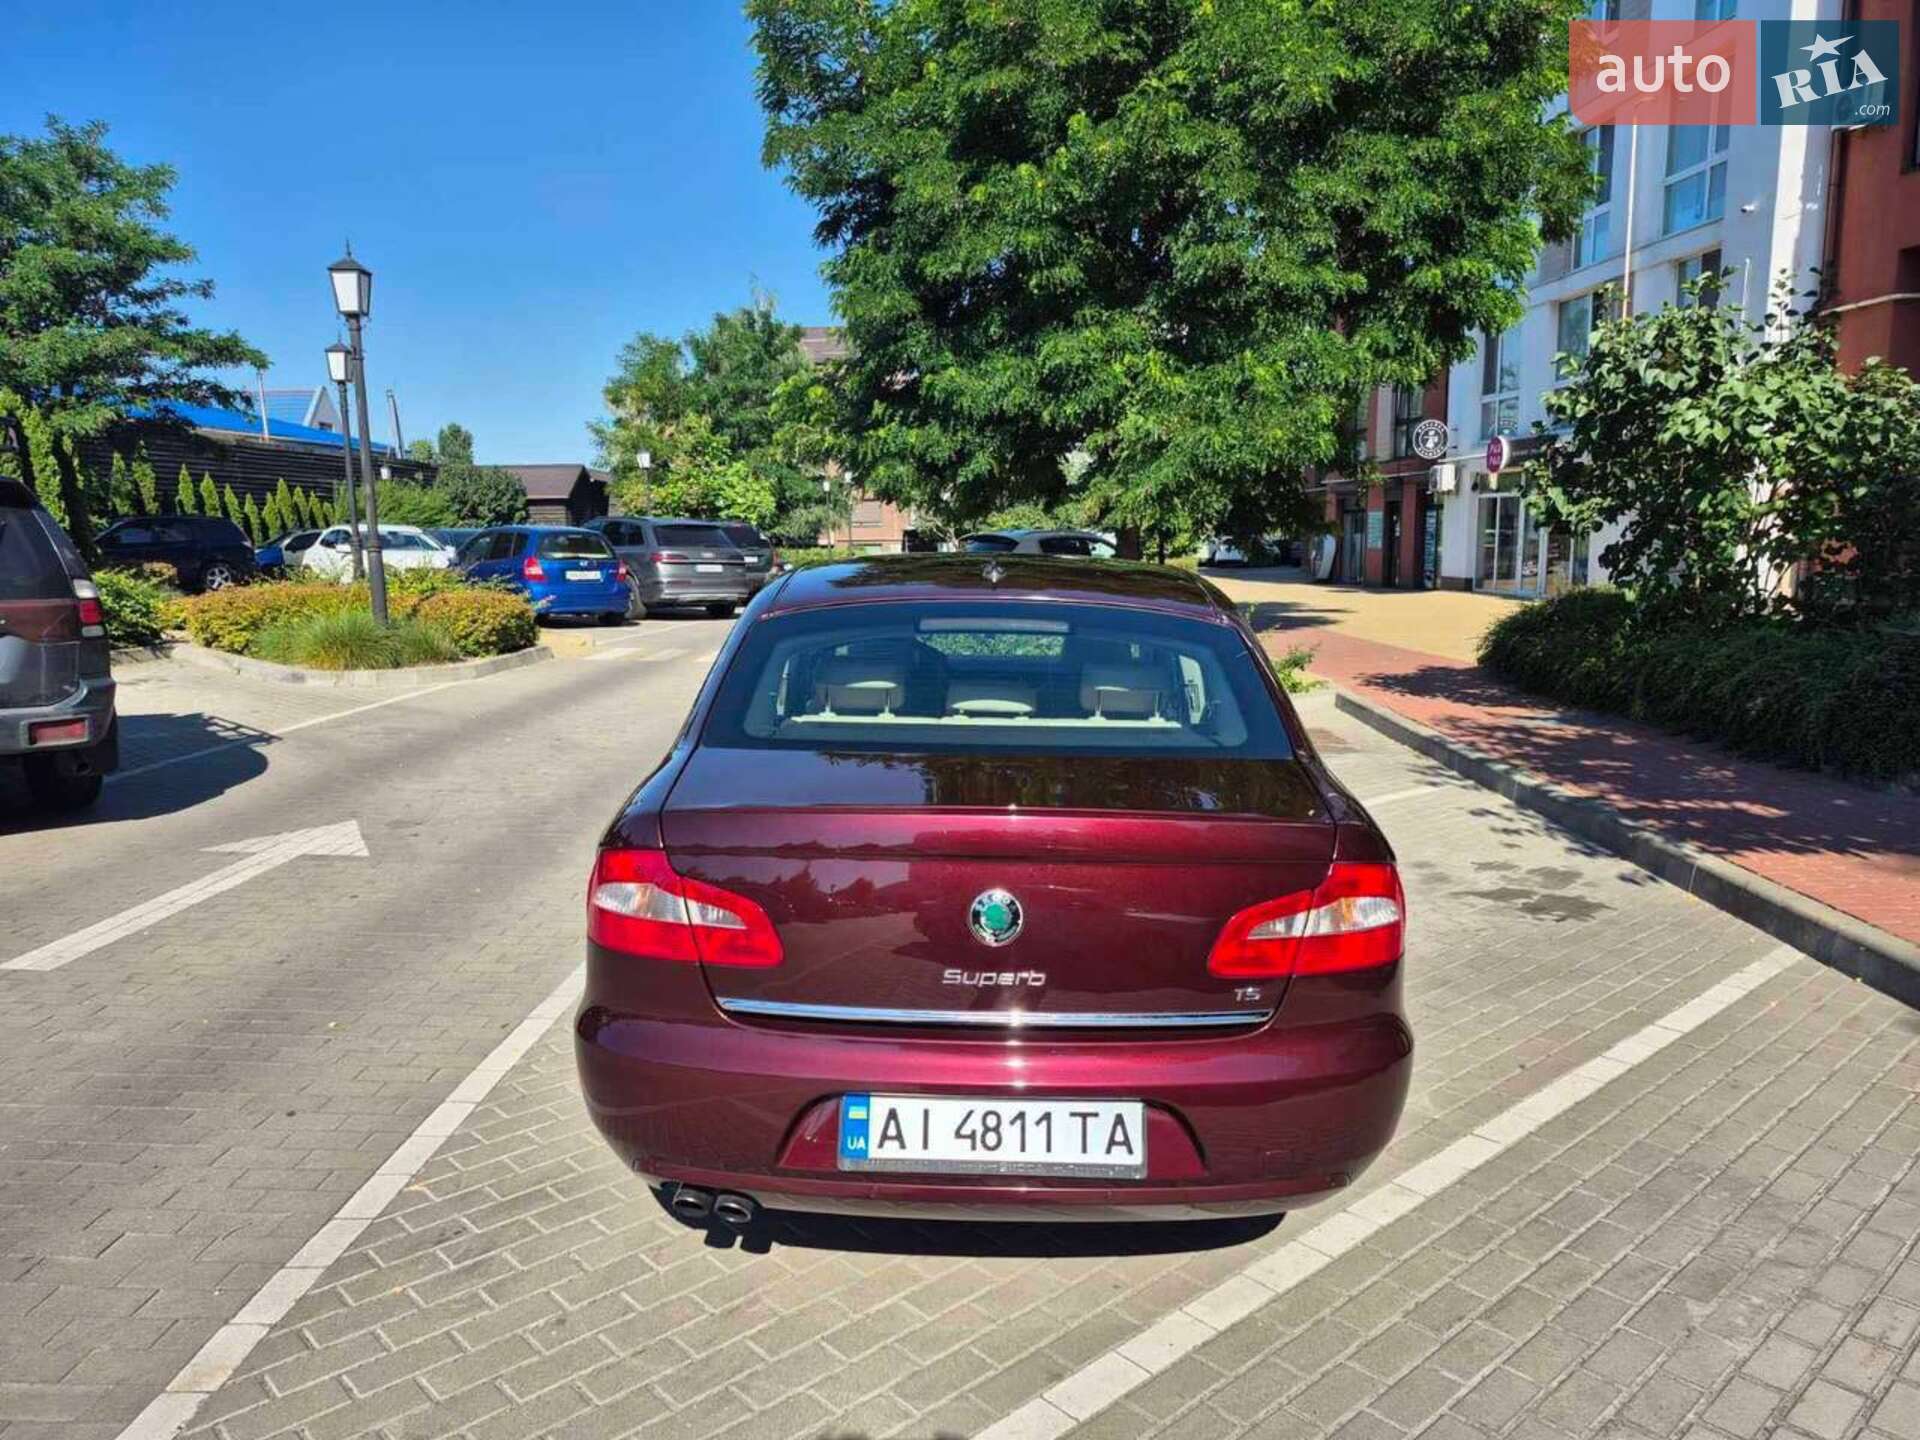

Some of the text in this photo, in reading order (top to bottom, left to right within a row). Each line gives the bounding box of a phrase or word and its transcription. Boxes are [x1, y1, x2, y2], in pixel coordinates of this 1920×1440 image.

[942, 968, 1047, 988] Superb
[877, 1107, 1134, 1155] AI 4811 TA
[847, 1136, 867, 1151] UA
